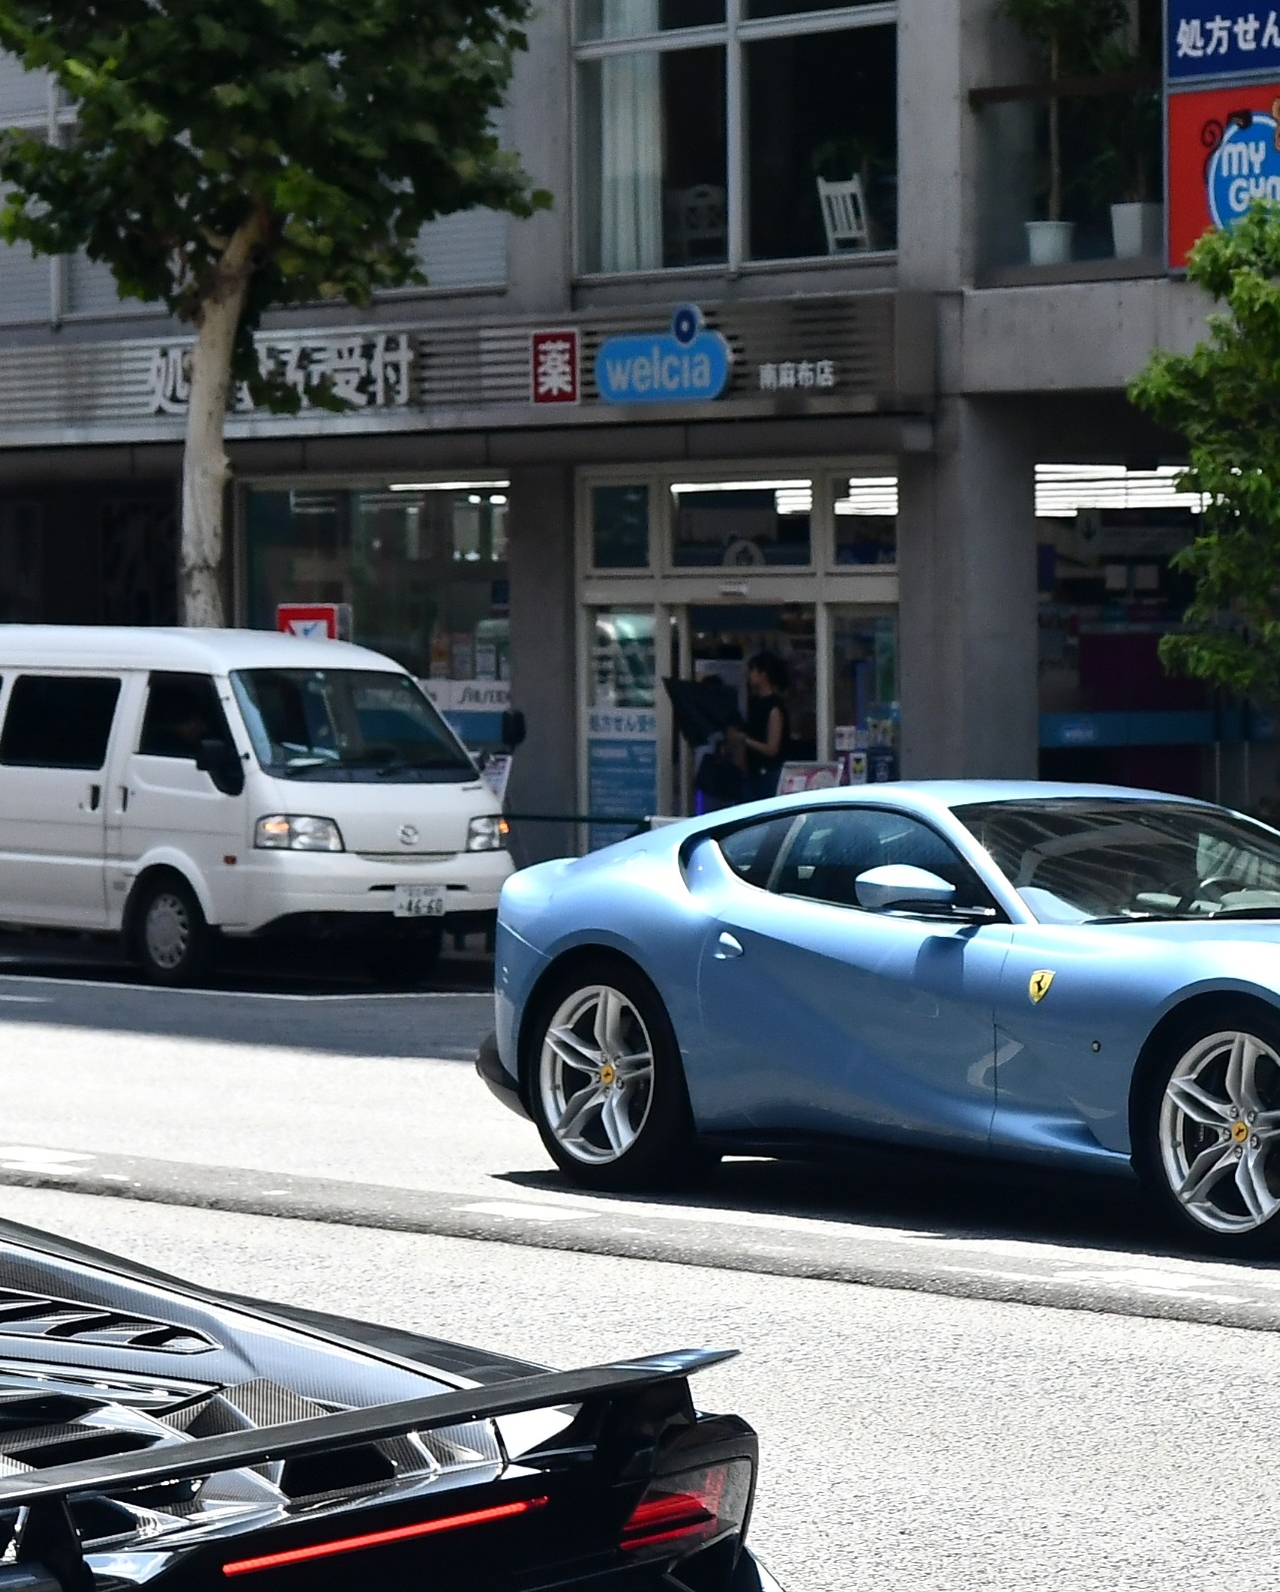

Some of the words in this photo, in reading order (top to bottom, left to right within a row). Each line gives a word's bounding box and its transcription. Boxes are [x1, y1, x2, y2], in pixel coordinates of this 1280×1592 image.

[537, 339, 573, 396] 薬
[605, 345, 712, 393] welcia
[758, 359, 836, 389] 南麻布店
